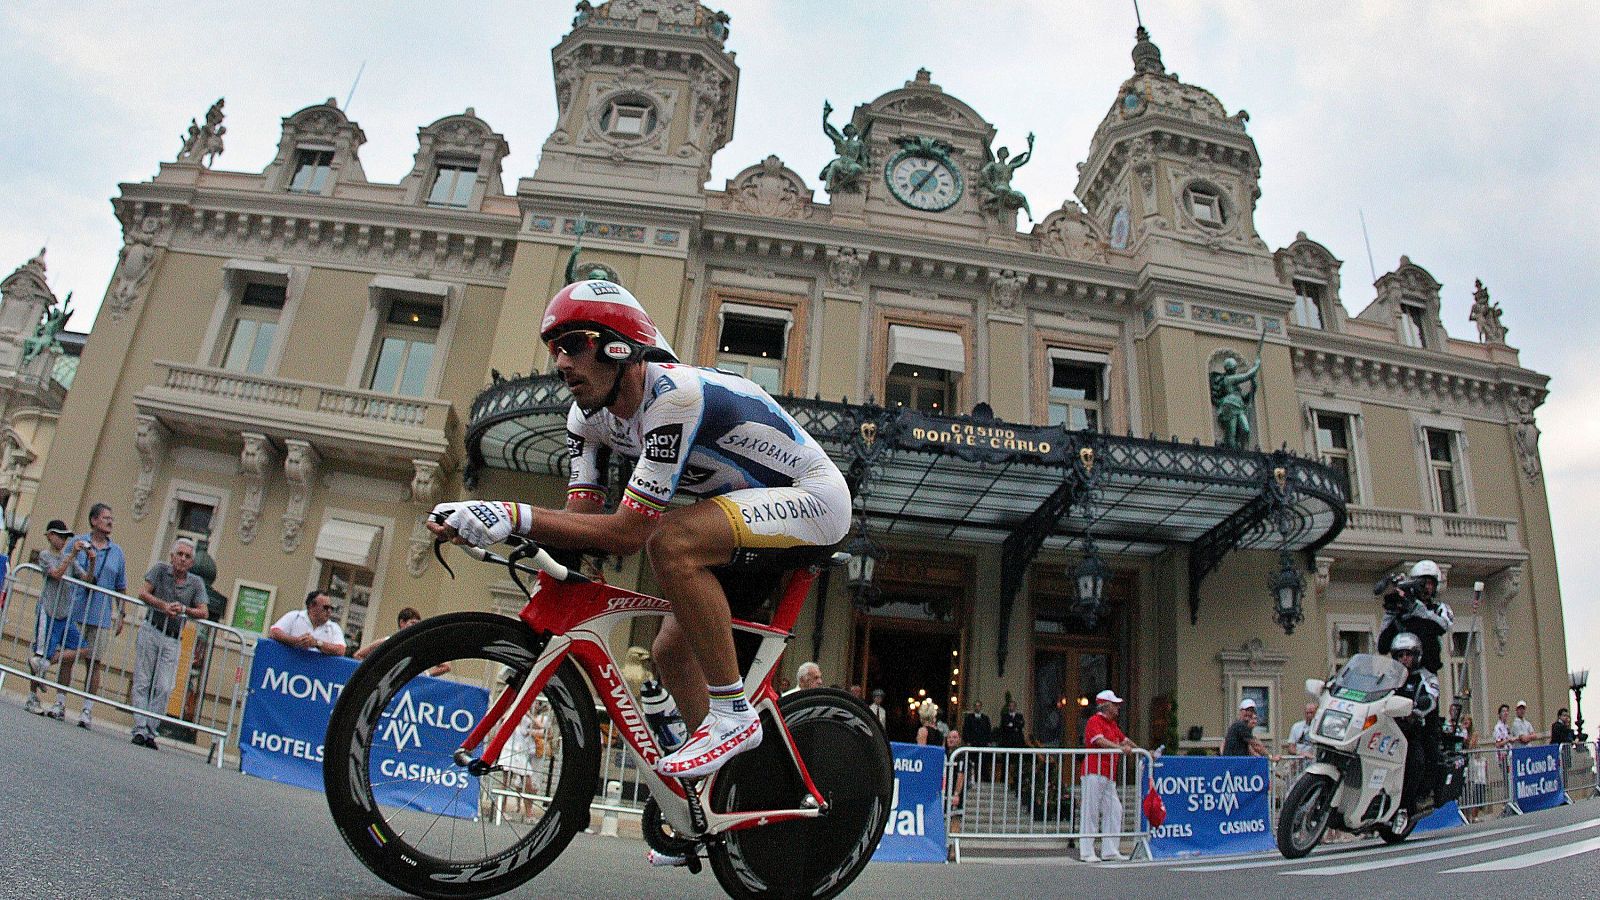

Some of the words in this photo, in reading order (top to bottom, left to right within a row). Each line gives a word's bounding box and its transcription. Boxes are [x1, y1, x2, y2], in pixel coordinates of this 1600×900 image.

[609, 346, 629, 355] BELL
[951, 423, 1015, 440] CASINO
[723, 434, 802, 469] SAXOBANK
[741, 495, 827, 524] SAXOBAN
[251, 729, 325, 762] HOTELS
[380, 759, 469, 789] CASINOS
[893, 758, 923, 772] ARLO
[1219, 819, 1265, 835] CASINOS
